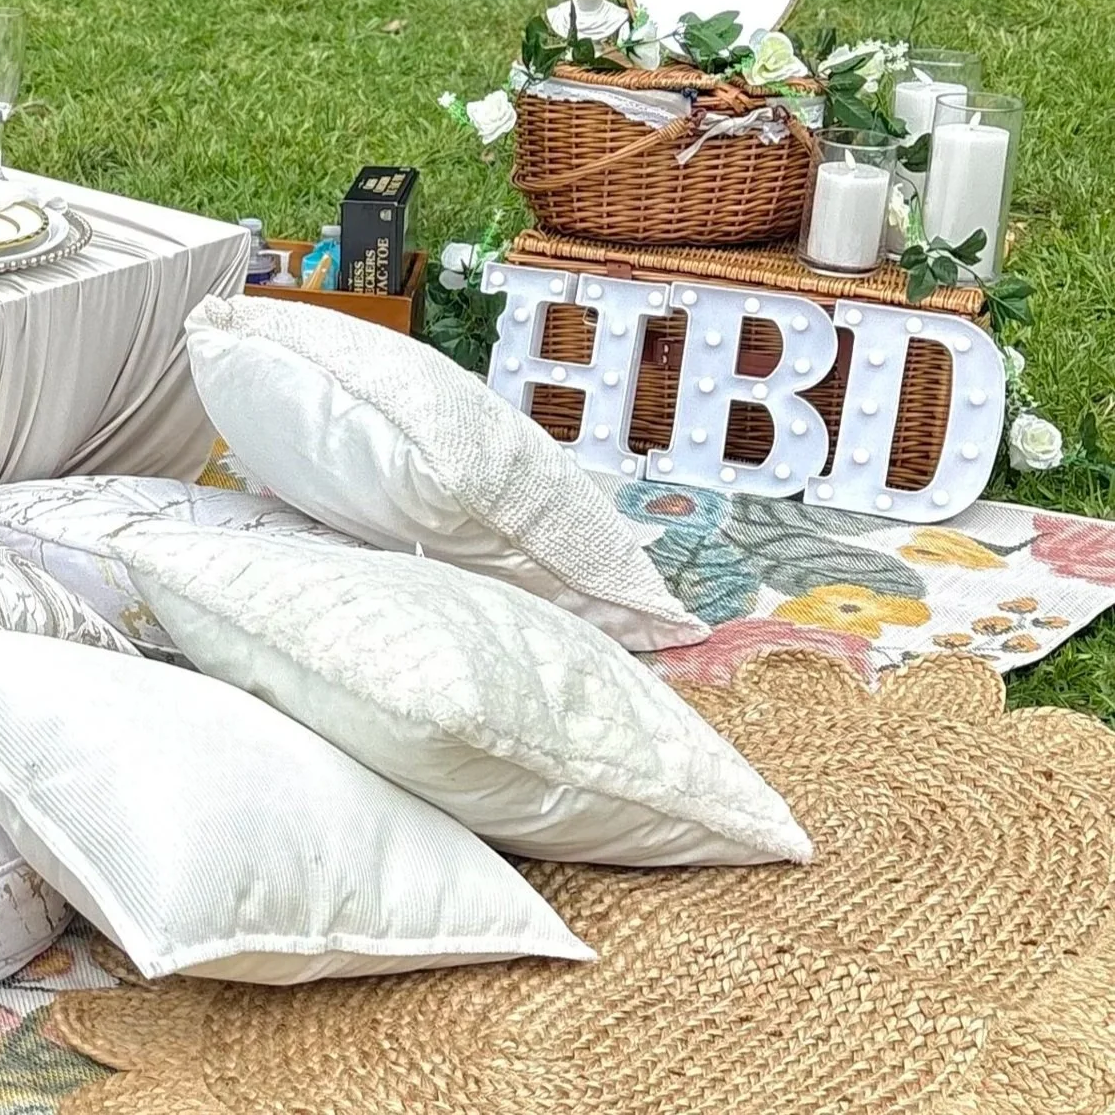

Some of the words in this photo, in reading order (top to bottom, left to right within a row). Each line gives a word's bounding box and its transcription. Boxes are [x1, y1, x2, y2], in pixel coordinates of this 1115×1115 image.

[354, 261, 364, 293] HESS
[365, 249, 375, 294] ECKERS
[481, 262, 1006, 524] HBD
